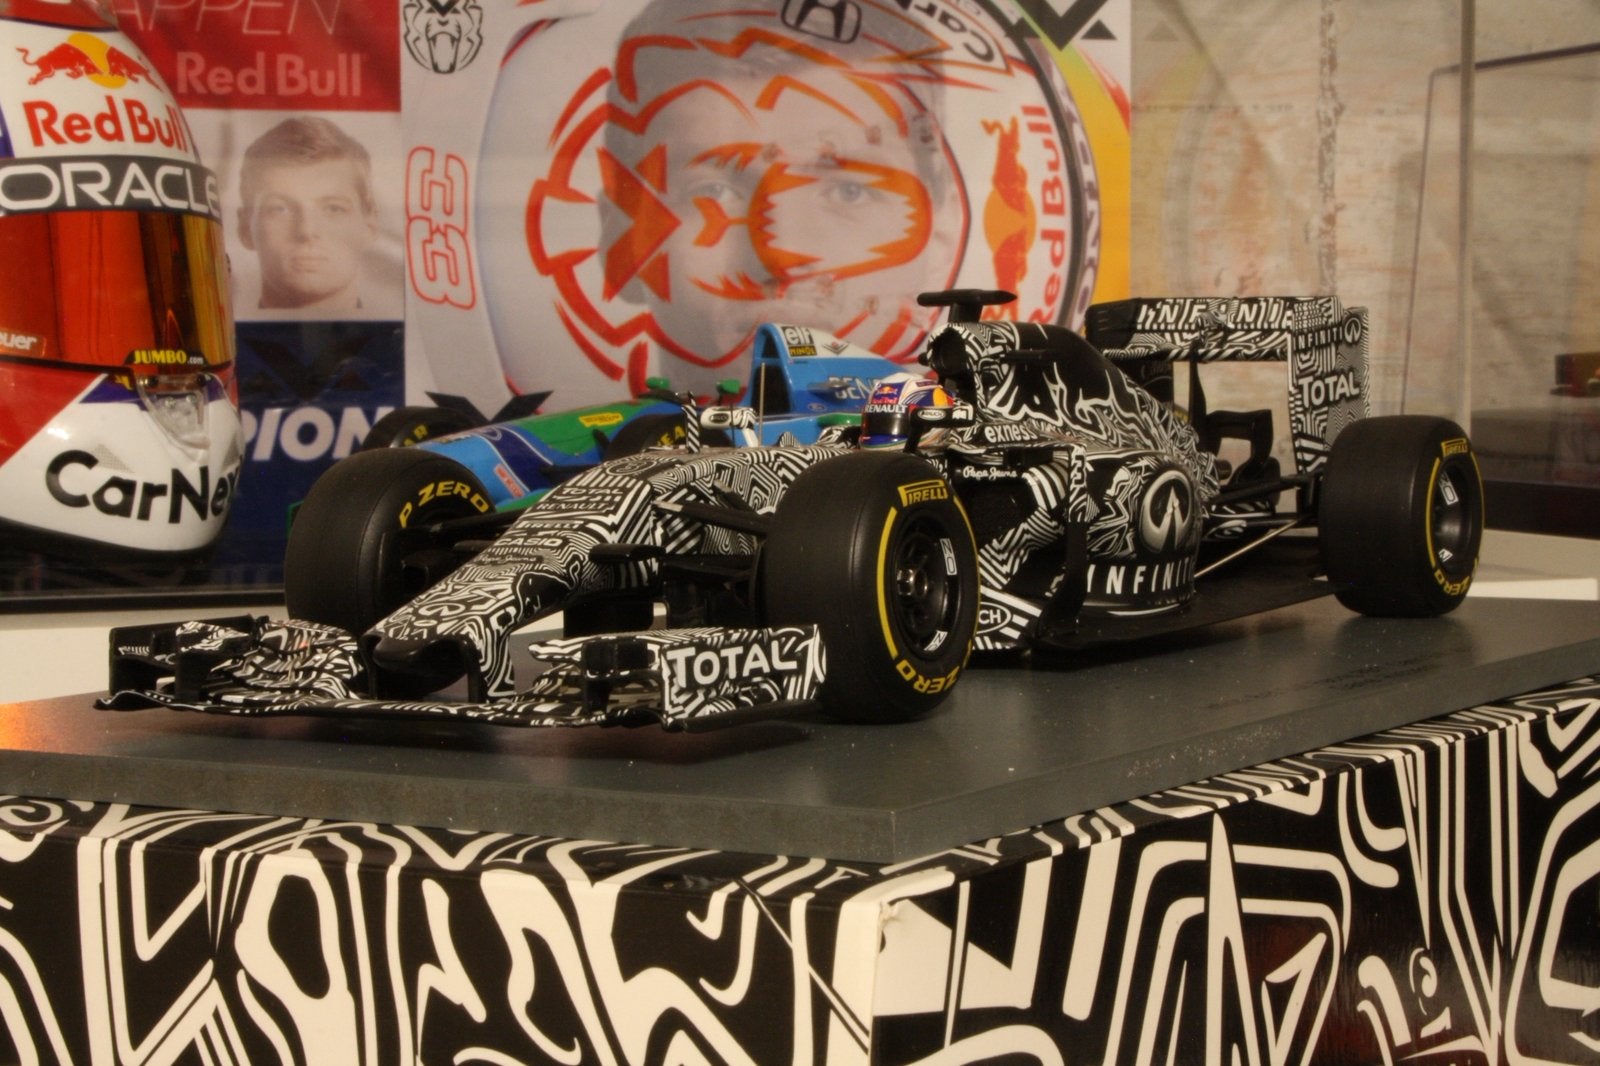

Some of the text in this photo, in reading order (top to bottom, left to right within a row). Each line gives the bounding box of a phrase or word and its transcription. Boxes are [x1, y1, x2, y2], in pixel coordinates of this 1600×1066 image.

[177, 51, 361, 97] Red Bull
[23, 96, 188, 153] Red Bull
[1021, 105, 1066, 216] Bull
[0, 162, 218, 213] ORACLE
[1293, 326, 1343, 351] INFINITI
[1298, 371, 1360, 408] TOTAL
[864, 403, 907, 413] RENAULT
[984, 424, 1038, 443] exness
[418, 480, 489, 513] ZERO
[562, 487, 623, 495] TOTAL
[897, 479, 948, 507] PIRELLI
[494, 537, 563, 547] CASIO
[666, 640, 798, 689] TOTAL
[896, 659, 960, 694] ZERO
